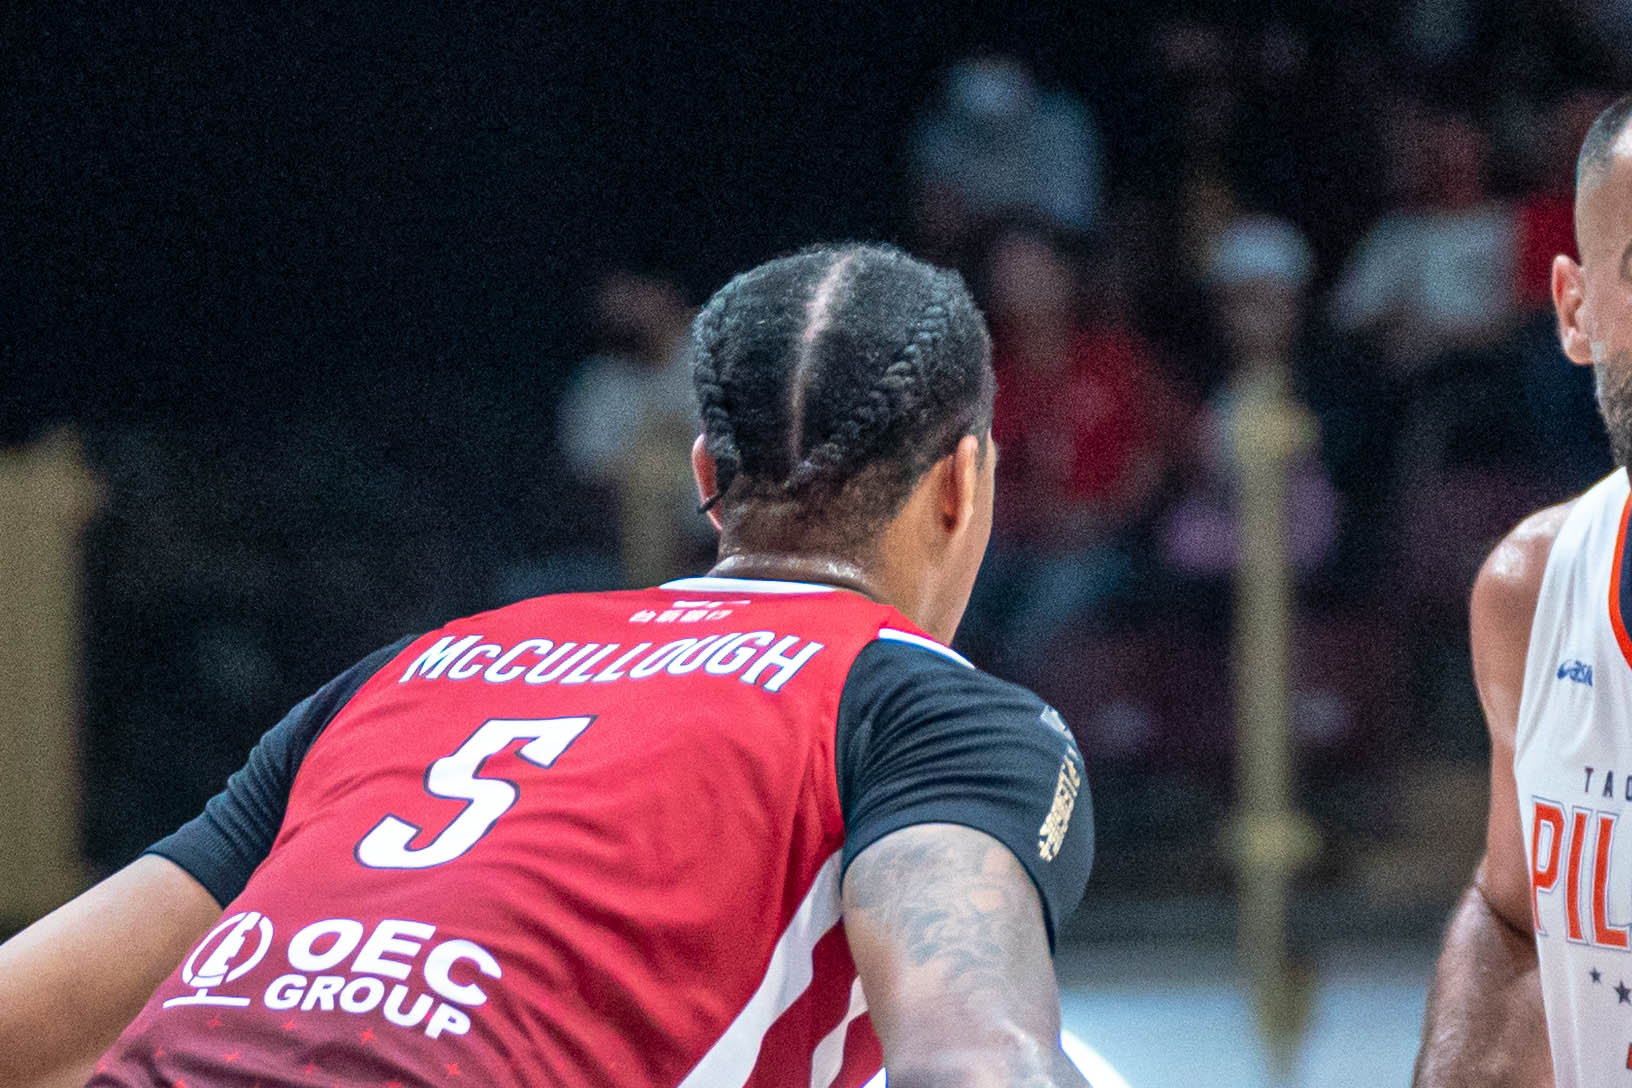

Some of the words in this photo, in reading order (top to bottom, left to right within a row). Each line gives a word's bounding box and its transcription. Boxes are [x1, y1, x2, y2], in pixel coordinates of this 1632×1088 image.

[399, 630, 825, 693] McCULLOUGH
[354, 714, 598, 869] 5
[287, 917, 502, 1008] OEC
[264, 972, 471, 1039] GROUP
